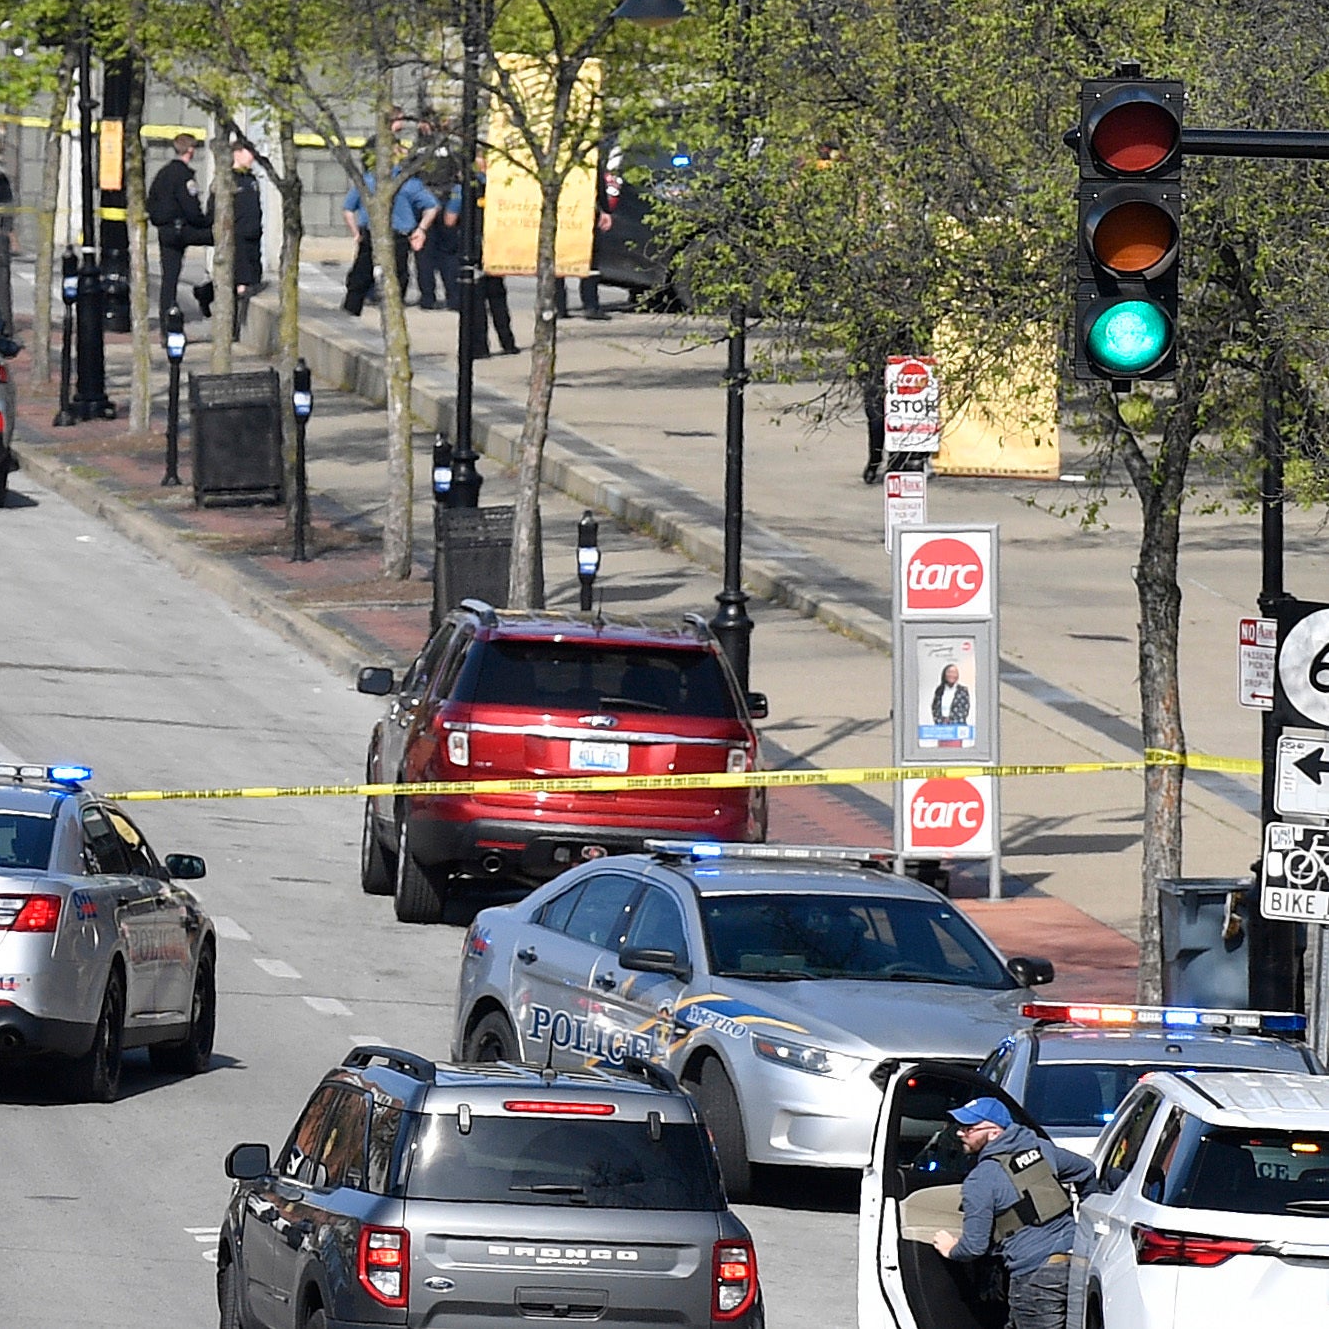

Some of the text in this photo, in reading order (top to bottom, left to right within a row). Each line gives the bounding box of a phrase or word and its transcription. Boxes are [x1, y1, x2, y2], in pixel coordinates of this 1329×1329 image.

[909, 559, 978, 591] tarc
[1242, 622, 1256, 643] NO
[912, 796, 979, 828] tarc
[1271, 891, 1316, 914] BIKE
[527, 1003, 653, 1064] POLICE
[687, 1004, 748, 1038] METRO
[1015, 1149, 1041, 1169] POLICE
[488, 1245, 639, 1261] BRONCO
